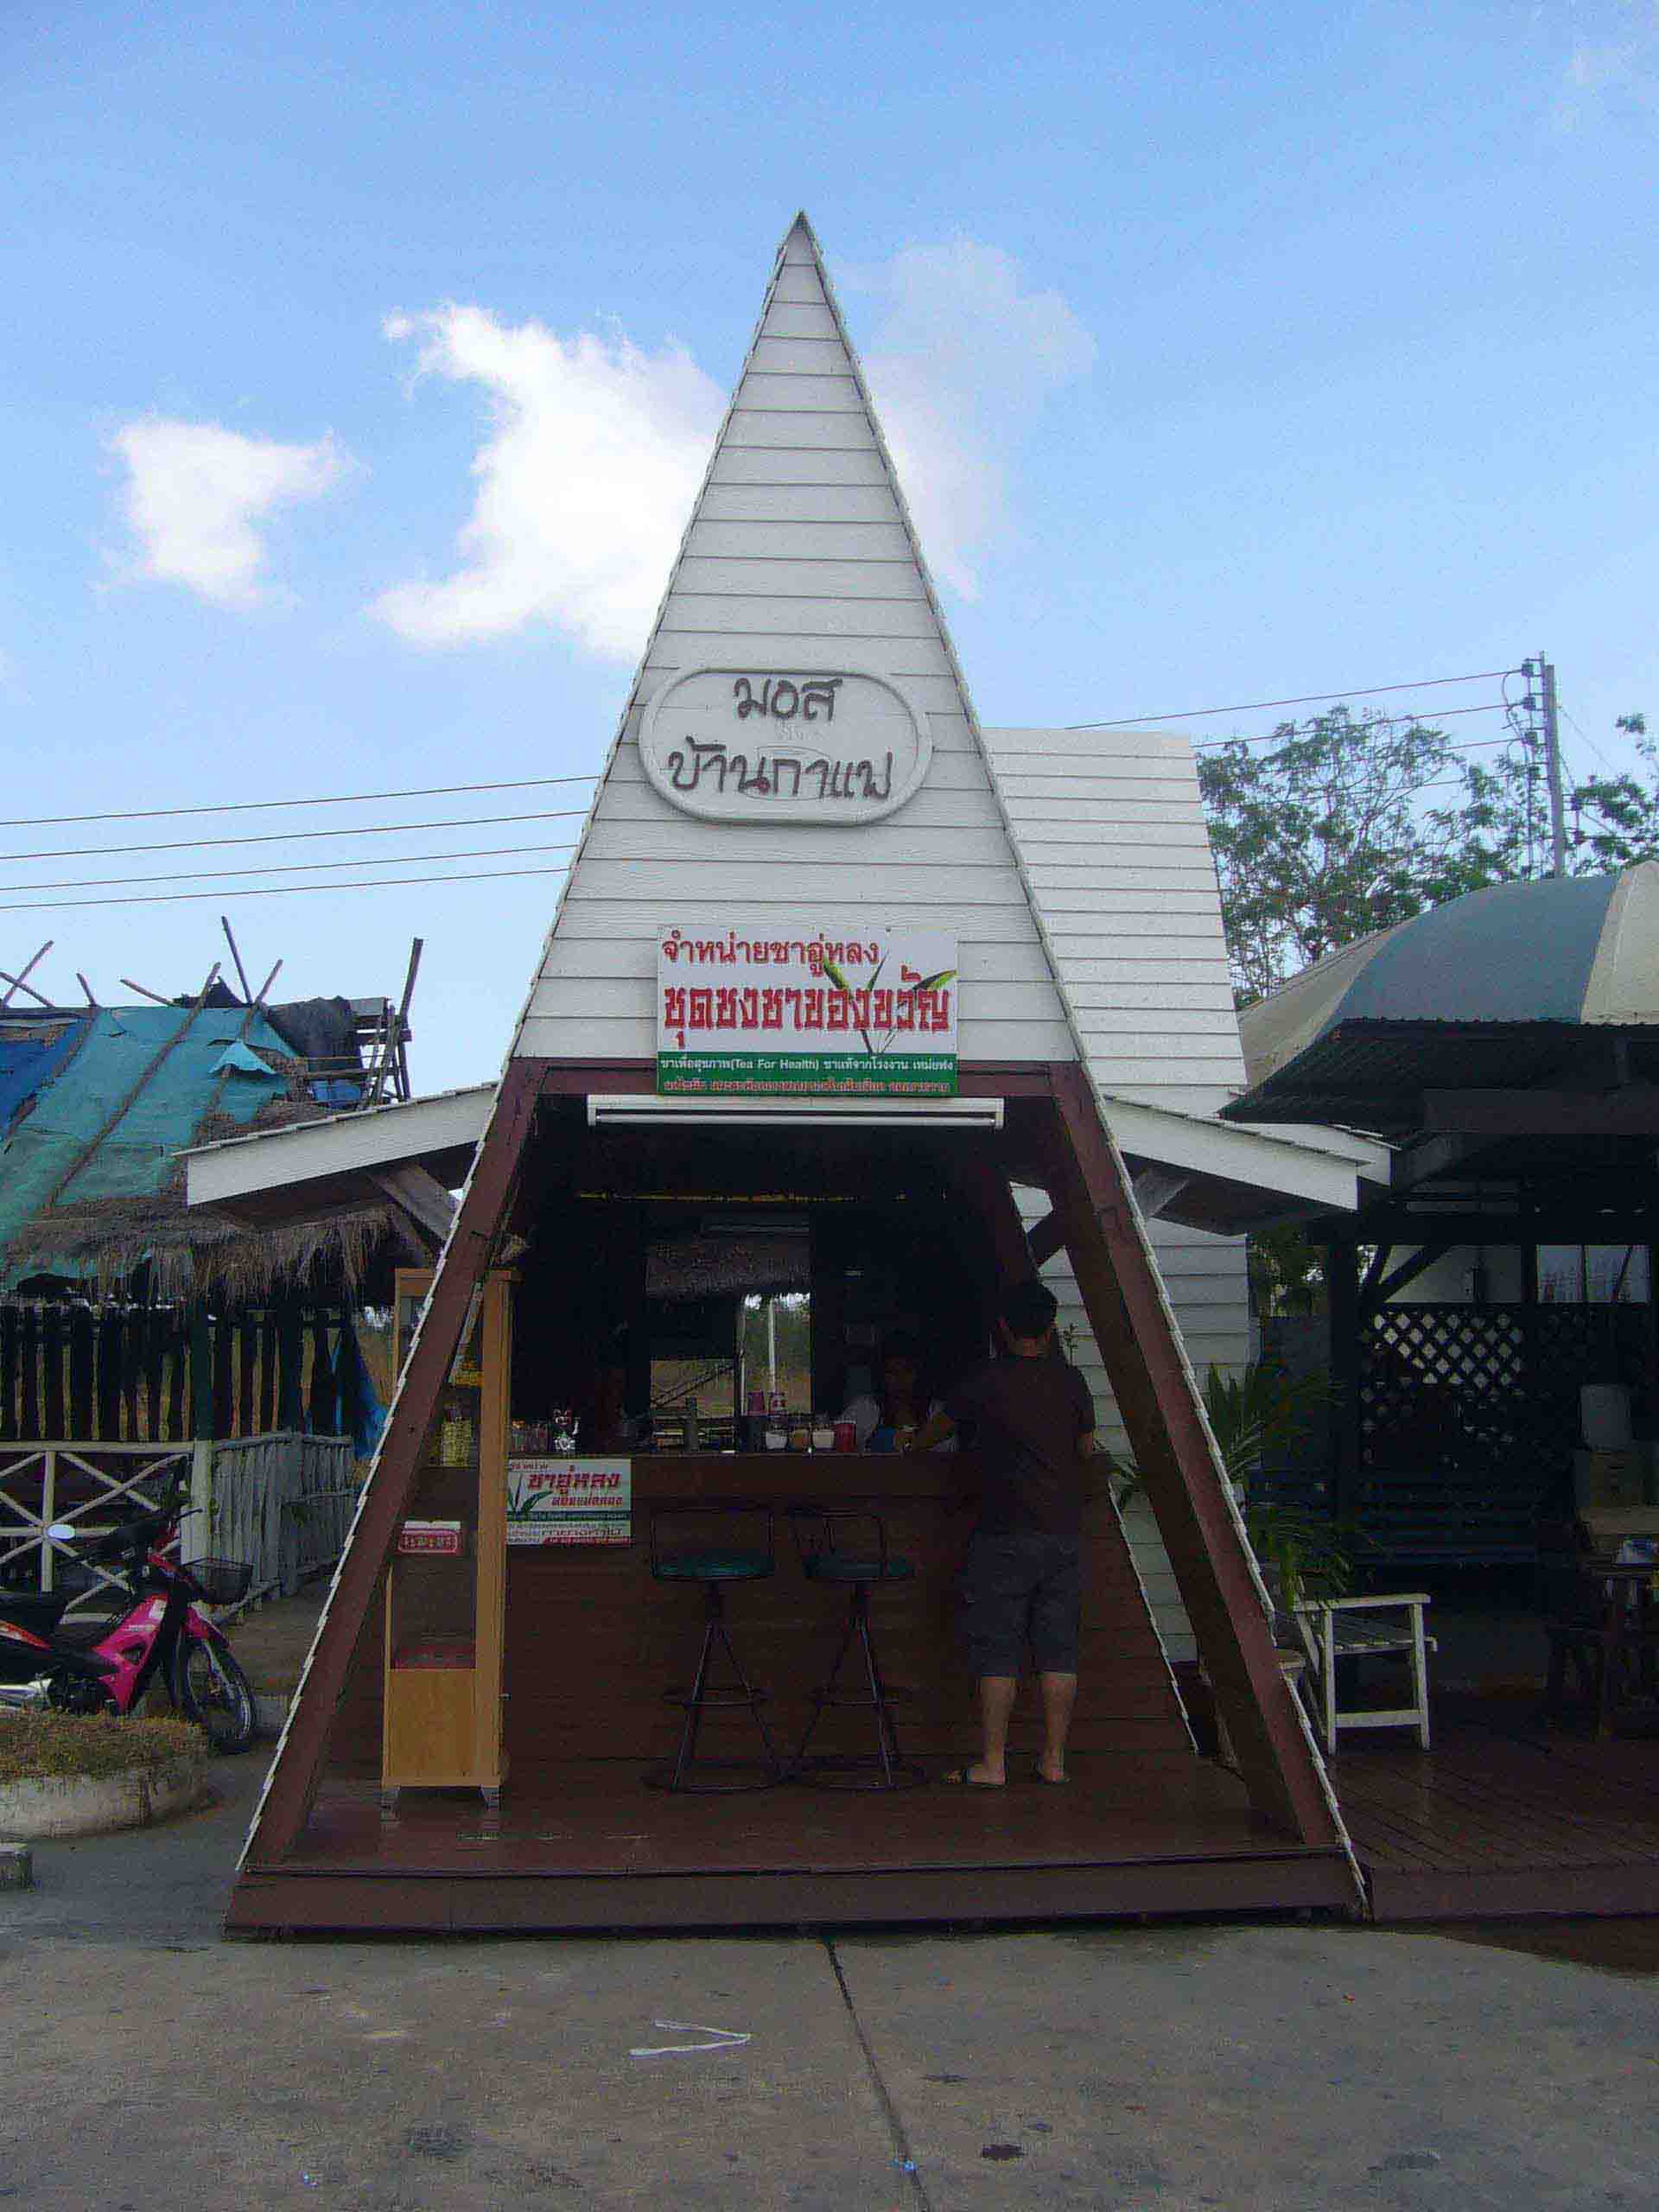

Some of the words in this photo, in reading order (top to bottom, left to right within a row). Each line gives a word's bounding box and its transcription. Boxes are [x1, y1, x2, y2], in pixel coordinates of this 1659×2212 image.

[734, 677, 842, 721] มอส
[662, 930, 880, 977] จำหน่ายชาอู่หลง
[664, 965, 950, 1050] ชุดชงชาของขวัญ
[758, 1058, 778, 1069] For
